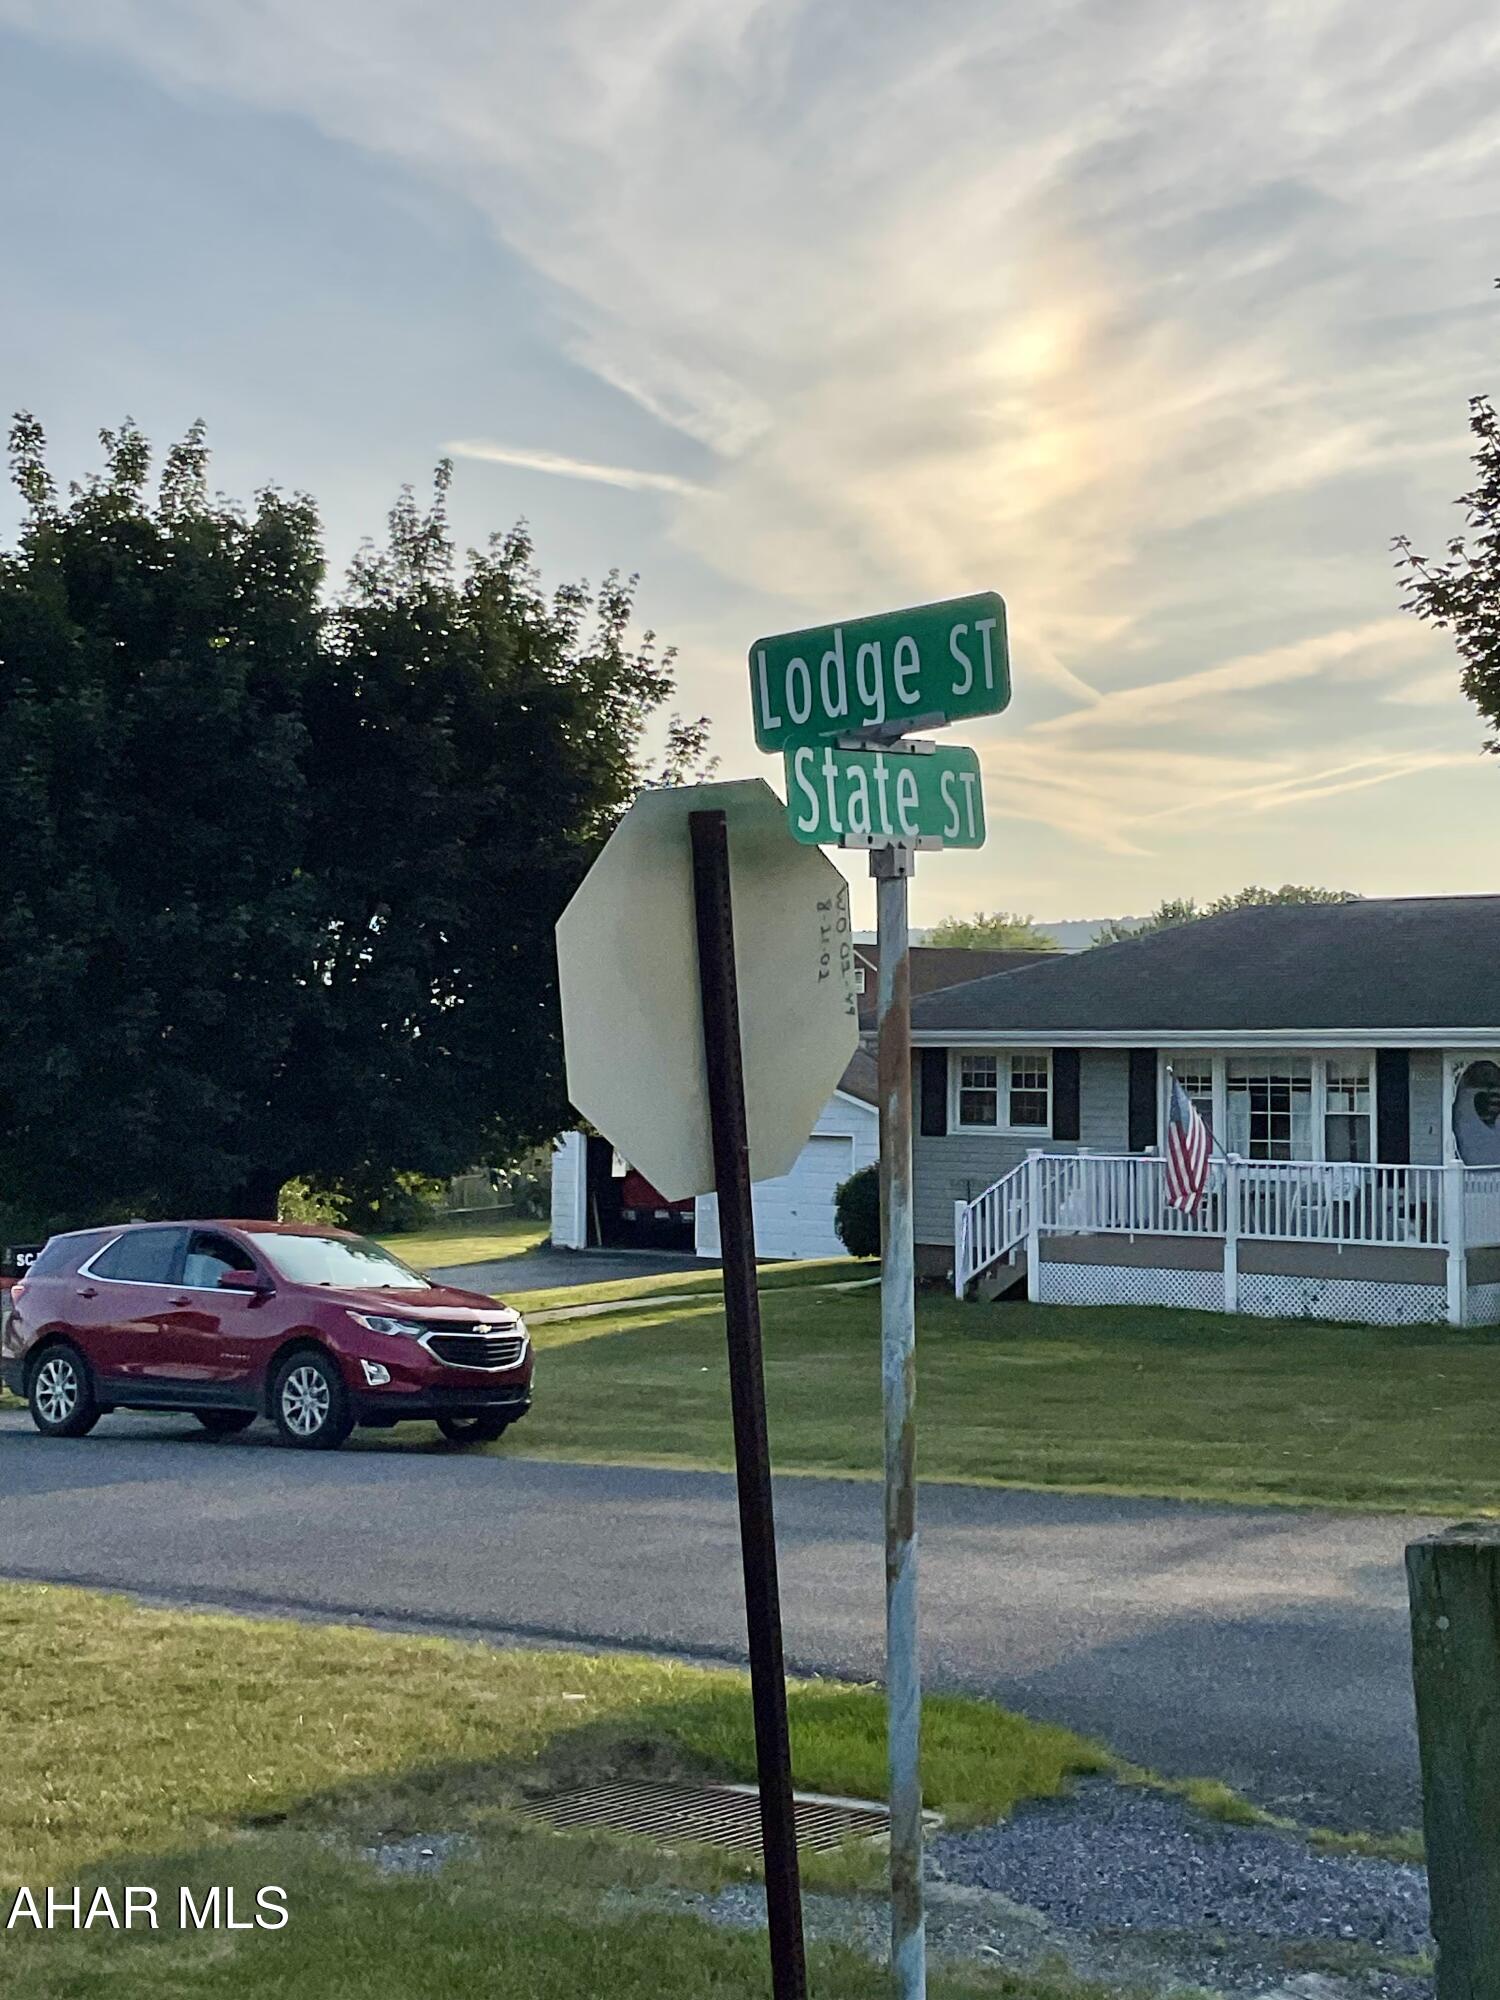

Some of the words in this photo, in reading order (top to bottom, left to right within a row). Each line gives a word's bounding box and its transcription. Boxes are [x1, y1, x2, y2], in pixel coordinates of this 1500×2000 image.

[757, 627, 921, 729] Lodge
[949, 618, 997, 695] ST
[794, 746, 920, 836] State
[940, 770, 976, 838] ST
